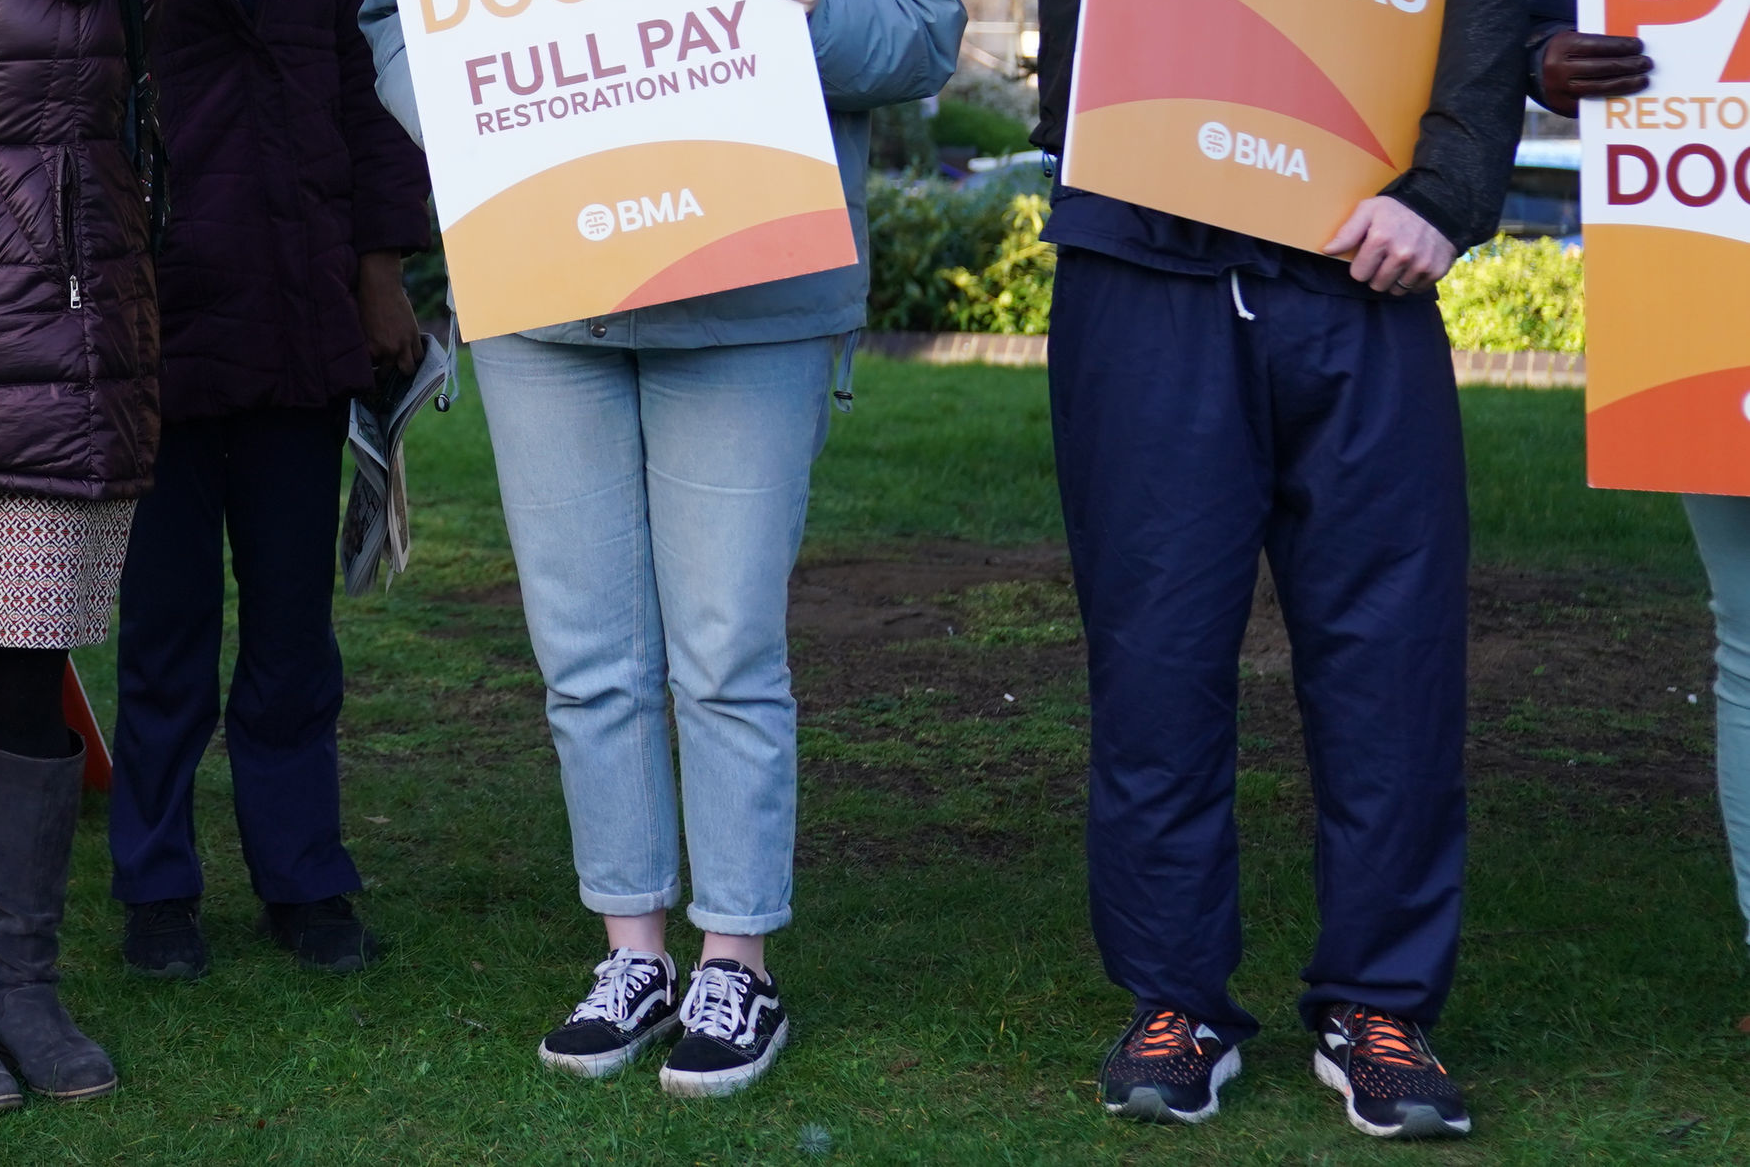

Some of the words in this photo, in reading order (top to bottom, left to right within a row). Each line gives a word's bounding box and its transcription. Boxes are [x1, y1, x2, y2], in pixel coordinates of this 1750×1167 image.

[465, 33, 627, 106] FULL
[637, 0, 747, 69] PAY
[475, 71, 680, 136] RESTORATION
[687, 54, 757, 91] NOW
[1605, 96, 1750, 130] RESTO
[1234, 131, 1309, 182] BMA
[616, 187, 704, 233] BMA
